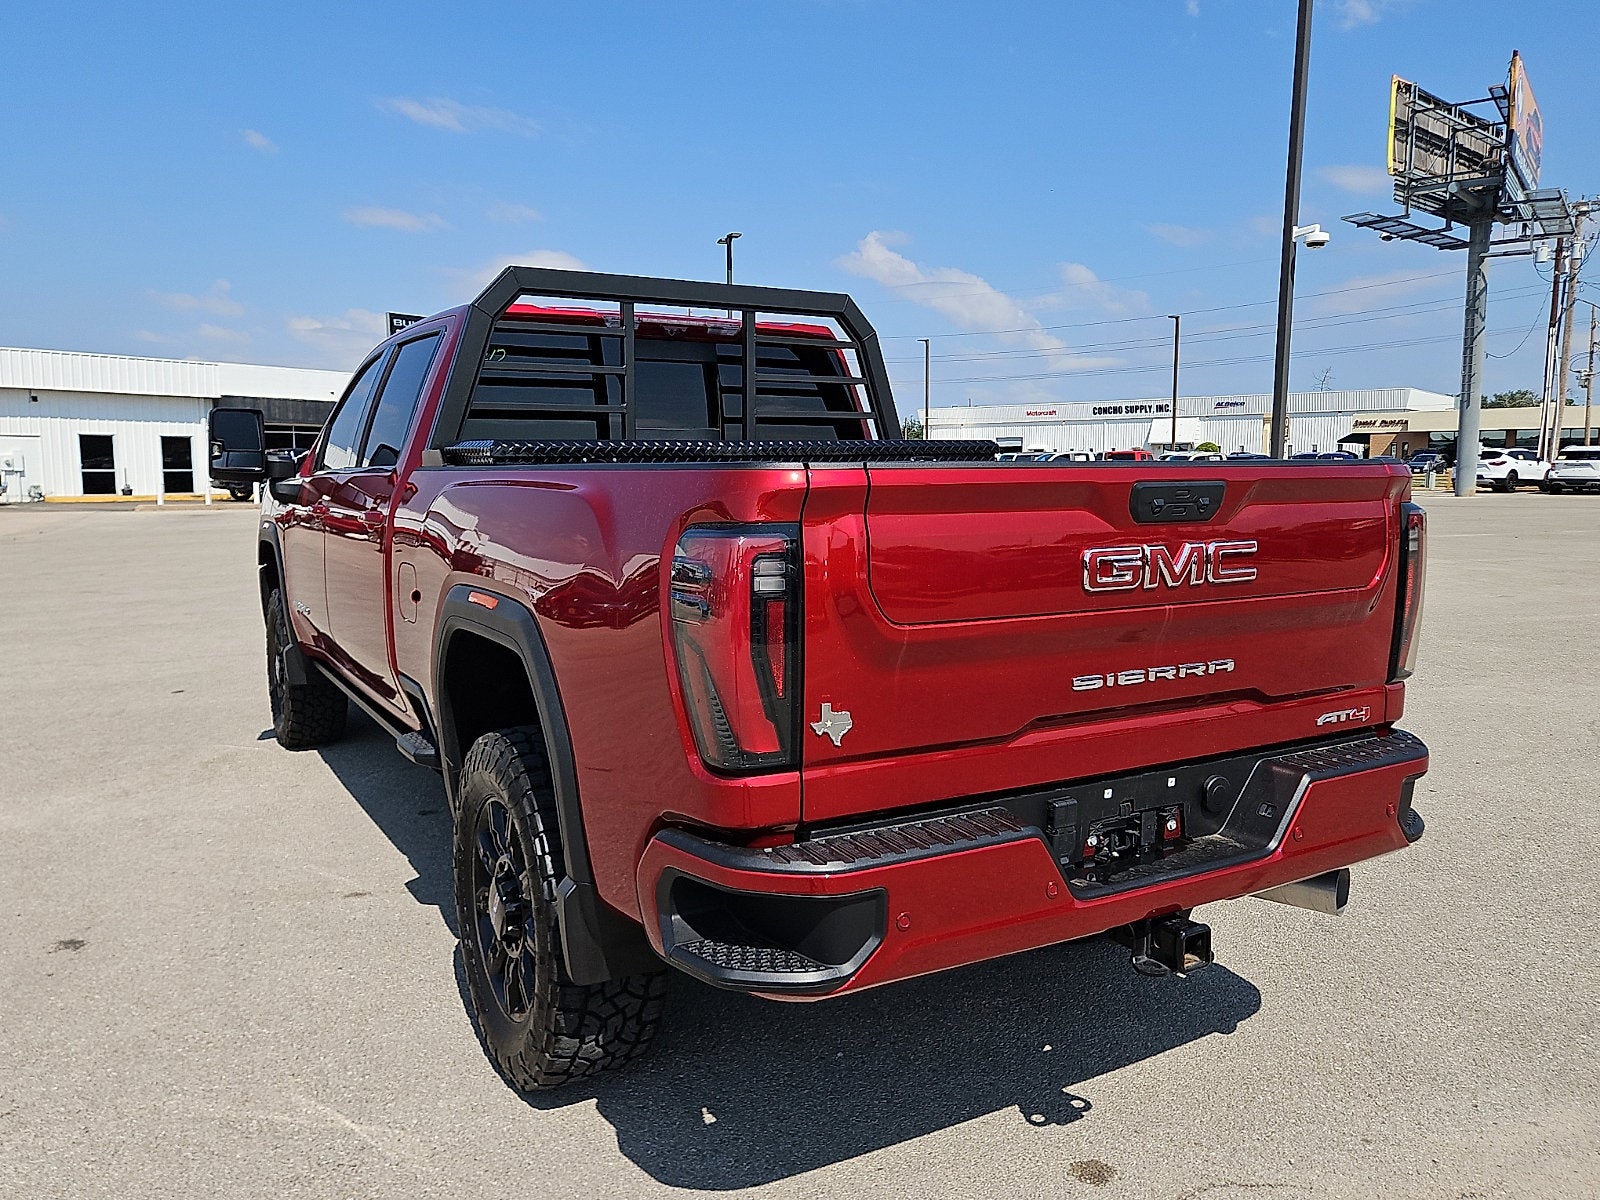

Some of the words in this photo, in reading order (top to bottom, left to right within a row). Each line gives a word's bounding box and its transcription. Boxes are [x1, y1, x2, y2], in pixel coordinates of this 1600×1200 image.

[1092, 406, 1123, 415] CONCHO
[1125, 405, 1155, 414] SUPPLY,
[1157, 404, 1172, 413] INC.
[1081, 540, 1258, 592] GMC
[1071, 658, 1235, 691] SIERRA
[1315, 705, 1371, 727] AT4
